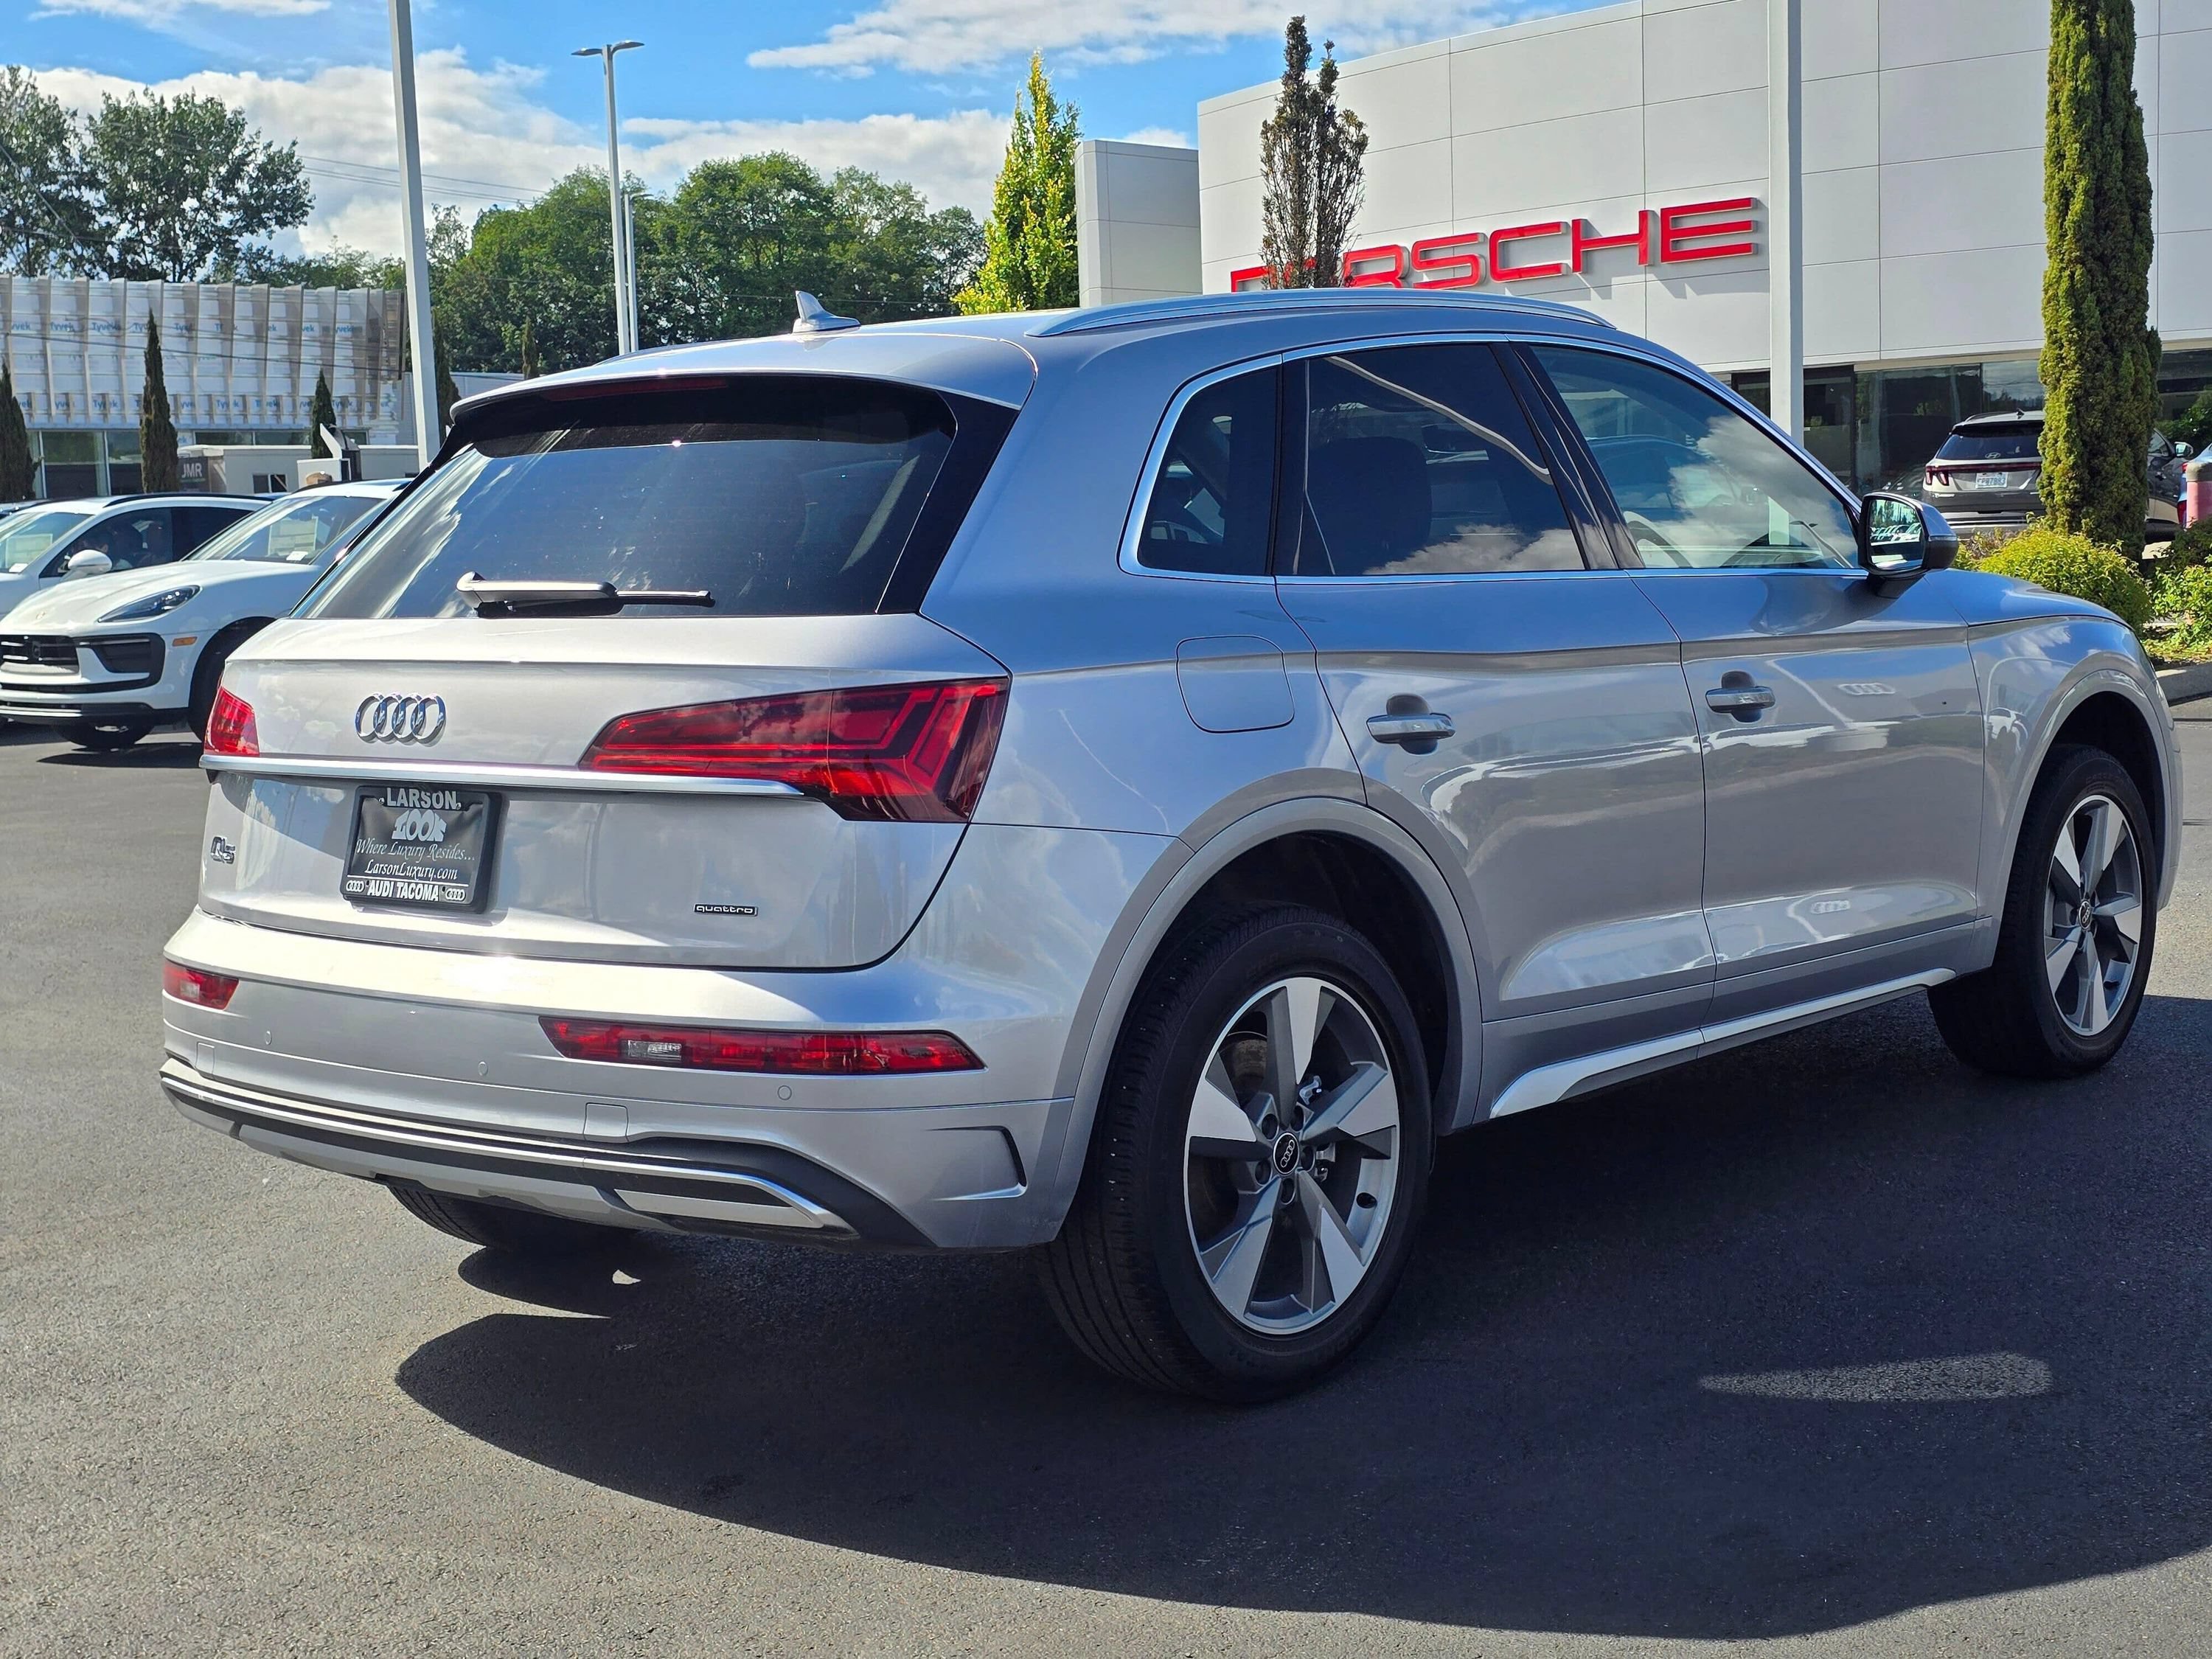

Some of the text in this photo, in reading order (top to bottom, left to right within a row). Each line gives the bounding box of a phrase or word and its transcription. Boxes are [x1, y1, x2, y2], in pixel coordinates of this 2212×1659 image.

[1231, 197, 1754, 293] RSCHE
[181, 462, 203, 479] JMR
[386, 787, 457, 810] LARSON
[210, 835, 236, 865] Q5
[355, 838, 476, 863] Where Luxury Resides...
[364, 859, 458, 882] LarsonLuxury.com
[367, 880, 439, 902] AUDI TACOMA
[696, 905, 754, 914] quattro
